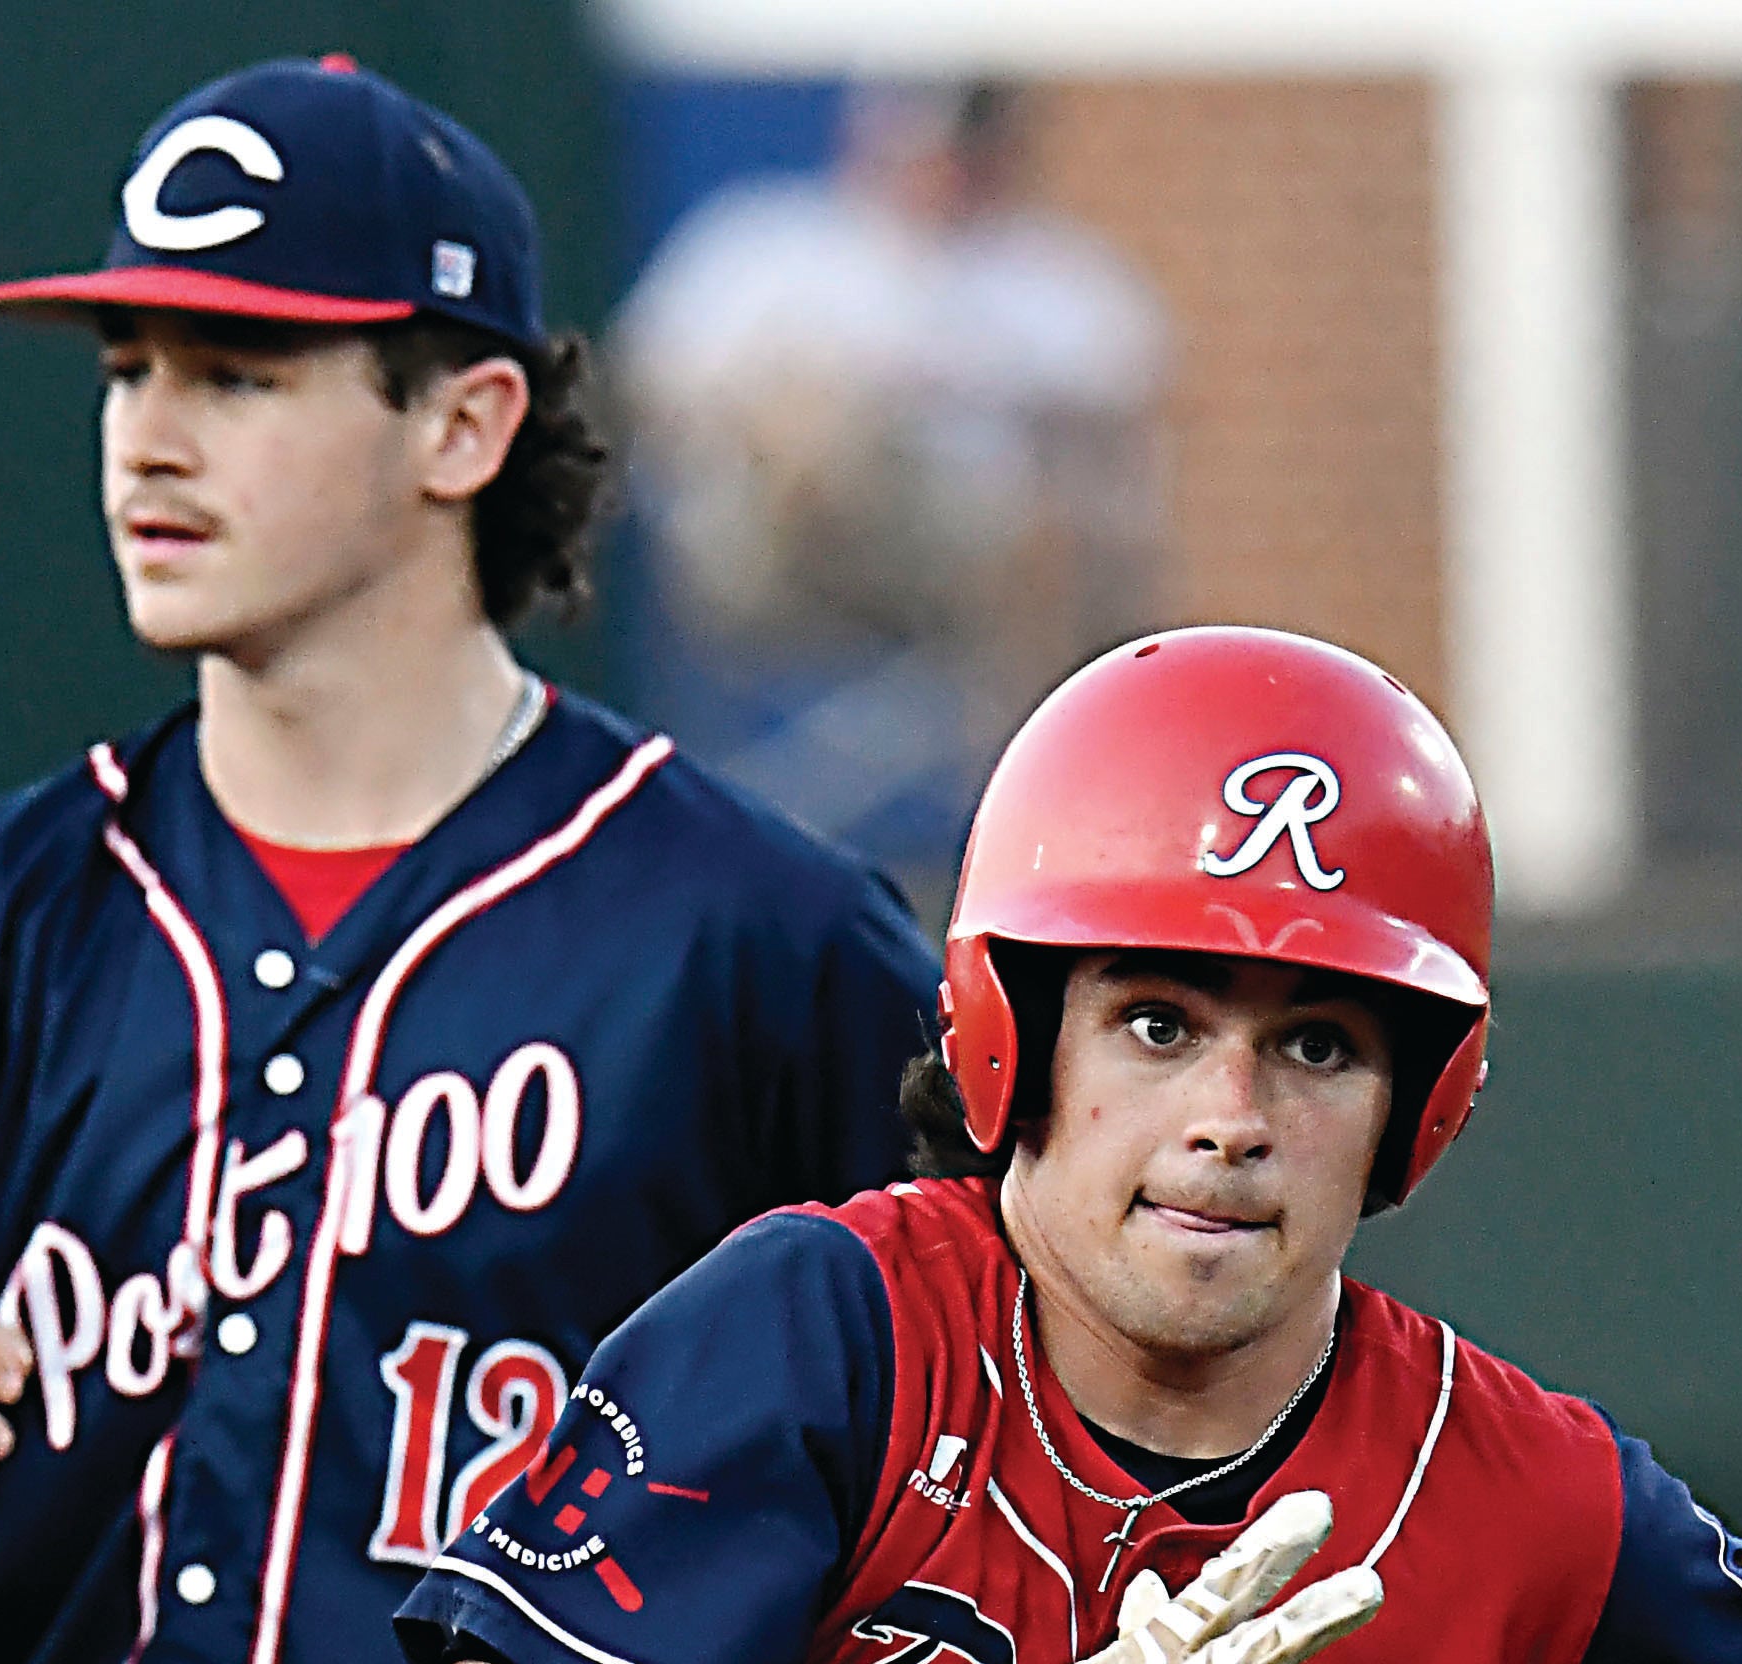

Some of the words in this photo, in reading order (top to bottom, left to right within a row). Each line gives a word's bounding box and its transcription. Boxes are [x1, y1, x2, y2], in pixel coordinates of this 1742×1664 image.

[121, 114, 284, 251] C
[1204, 750, 1346, 892] R
[330, 1041, 581, 1256] 100
[367, 1318, 569, 1568] 12
[487, 1526, 606, 1571] MEDICINE
